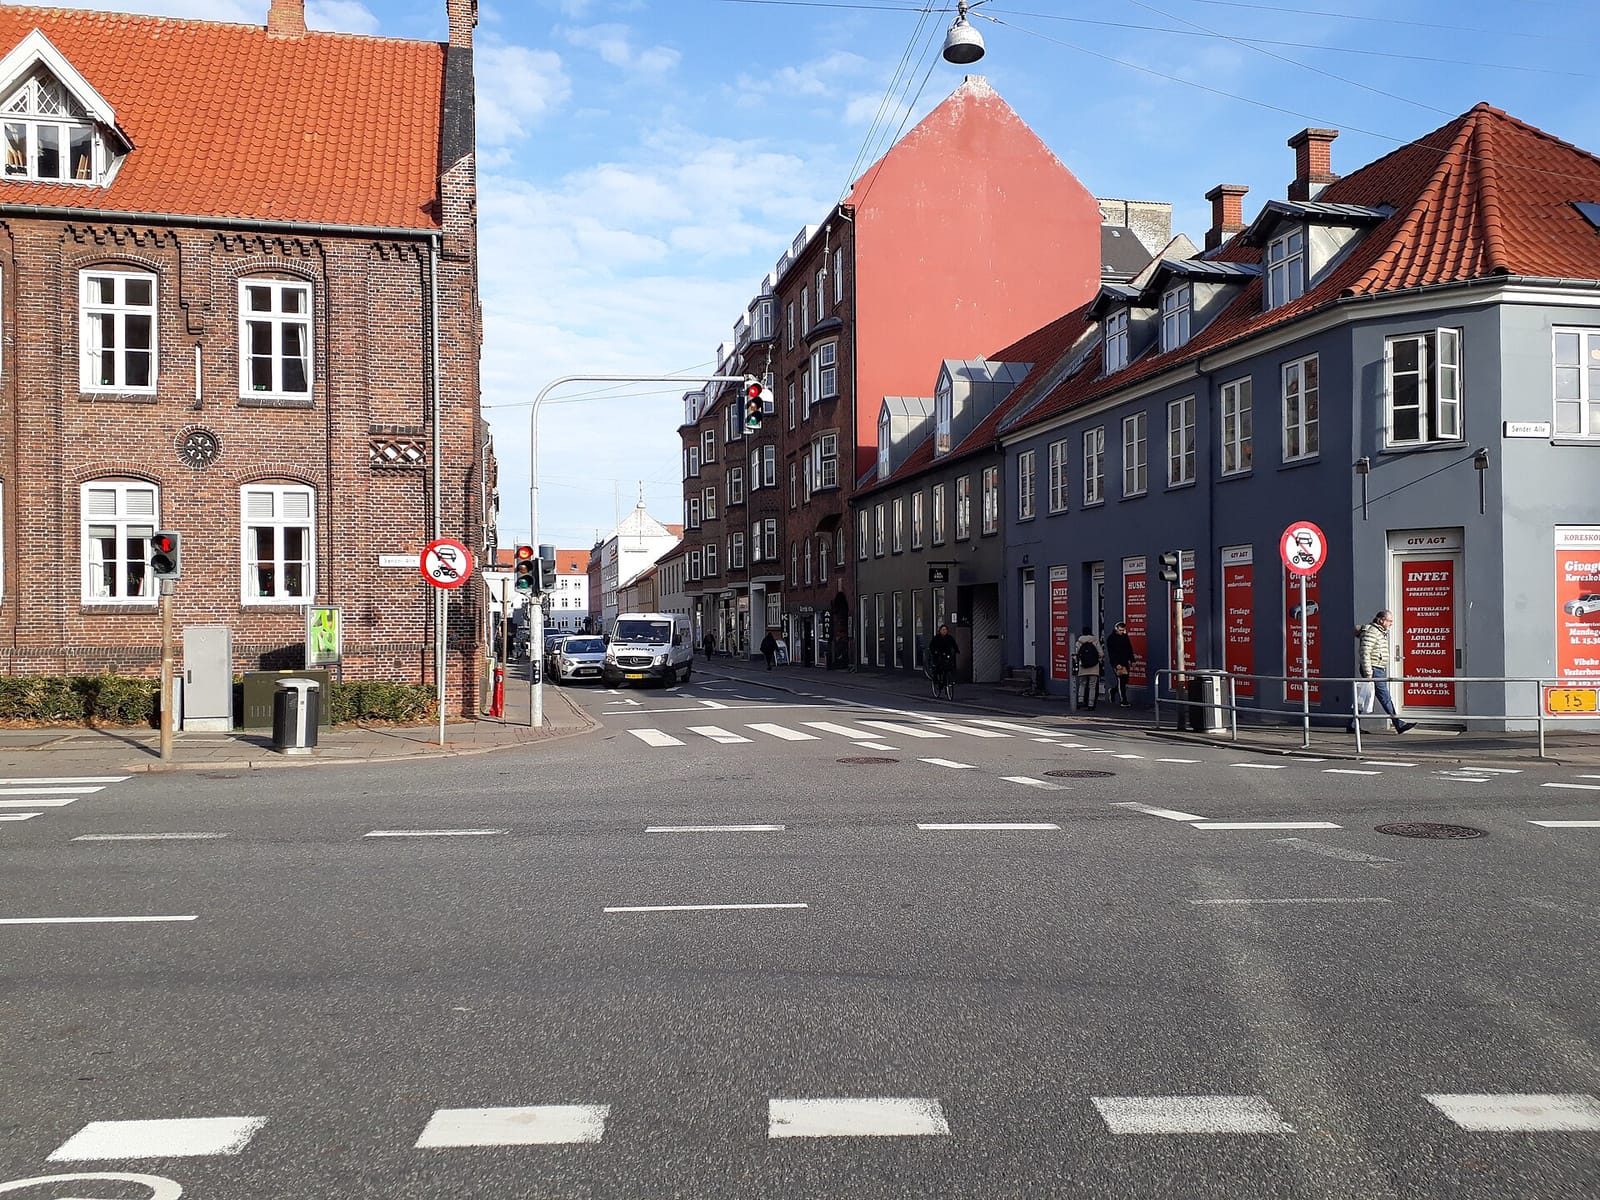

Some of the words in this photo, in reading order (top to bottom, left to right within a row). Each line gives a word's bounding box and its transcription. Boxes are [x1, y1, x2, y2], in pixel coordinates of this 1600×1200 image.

[1407, 572, 1449, 582] INTET
[1233, 664, 1248, 672] Peter
[1407, 688, 1451, 696] GIVAGT.DK
